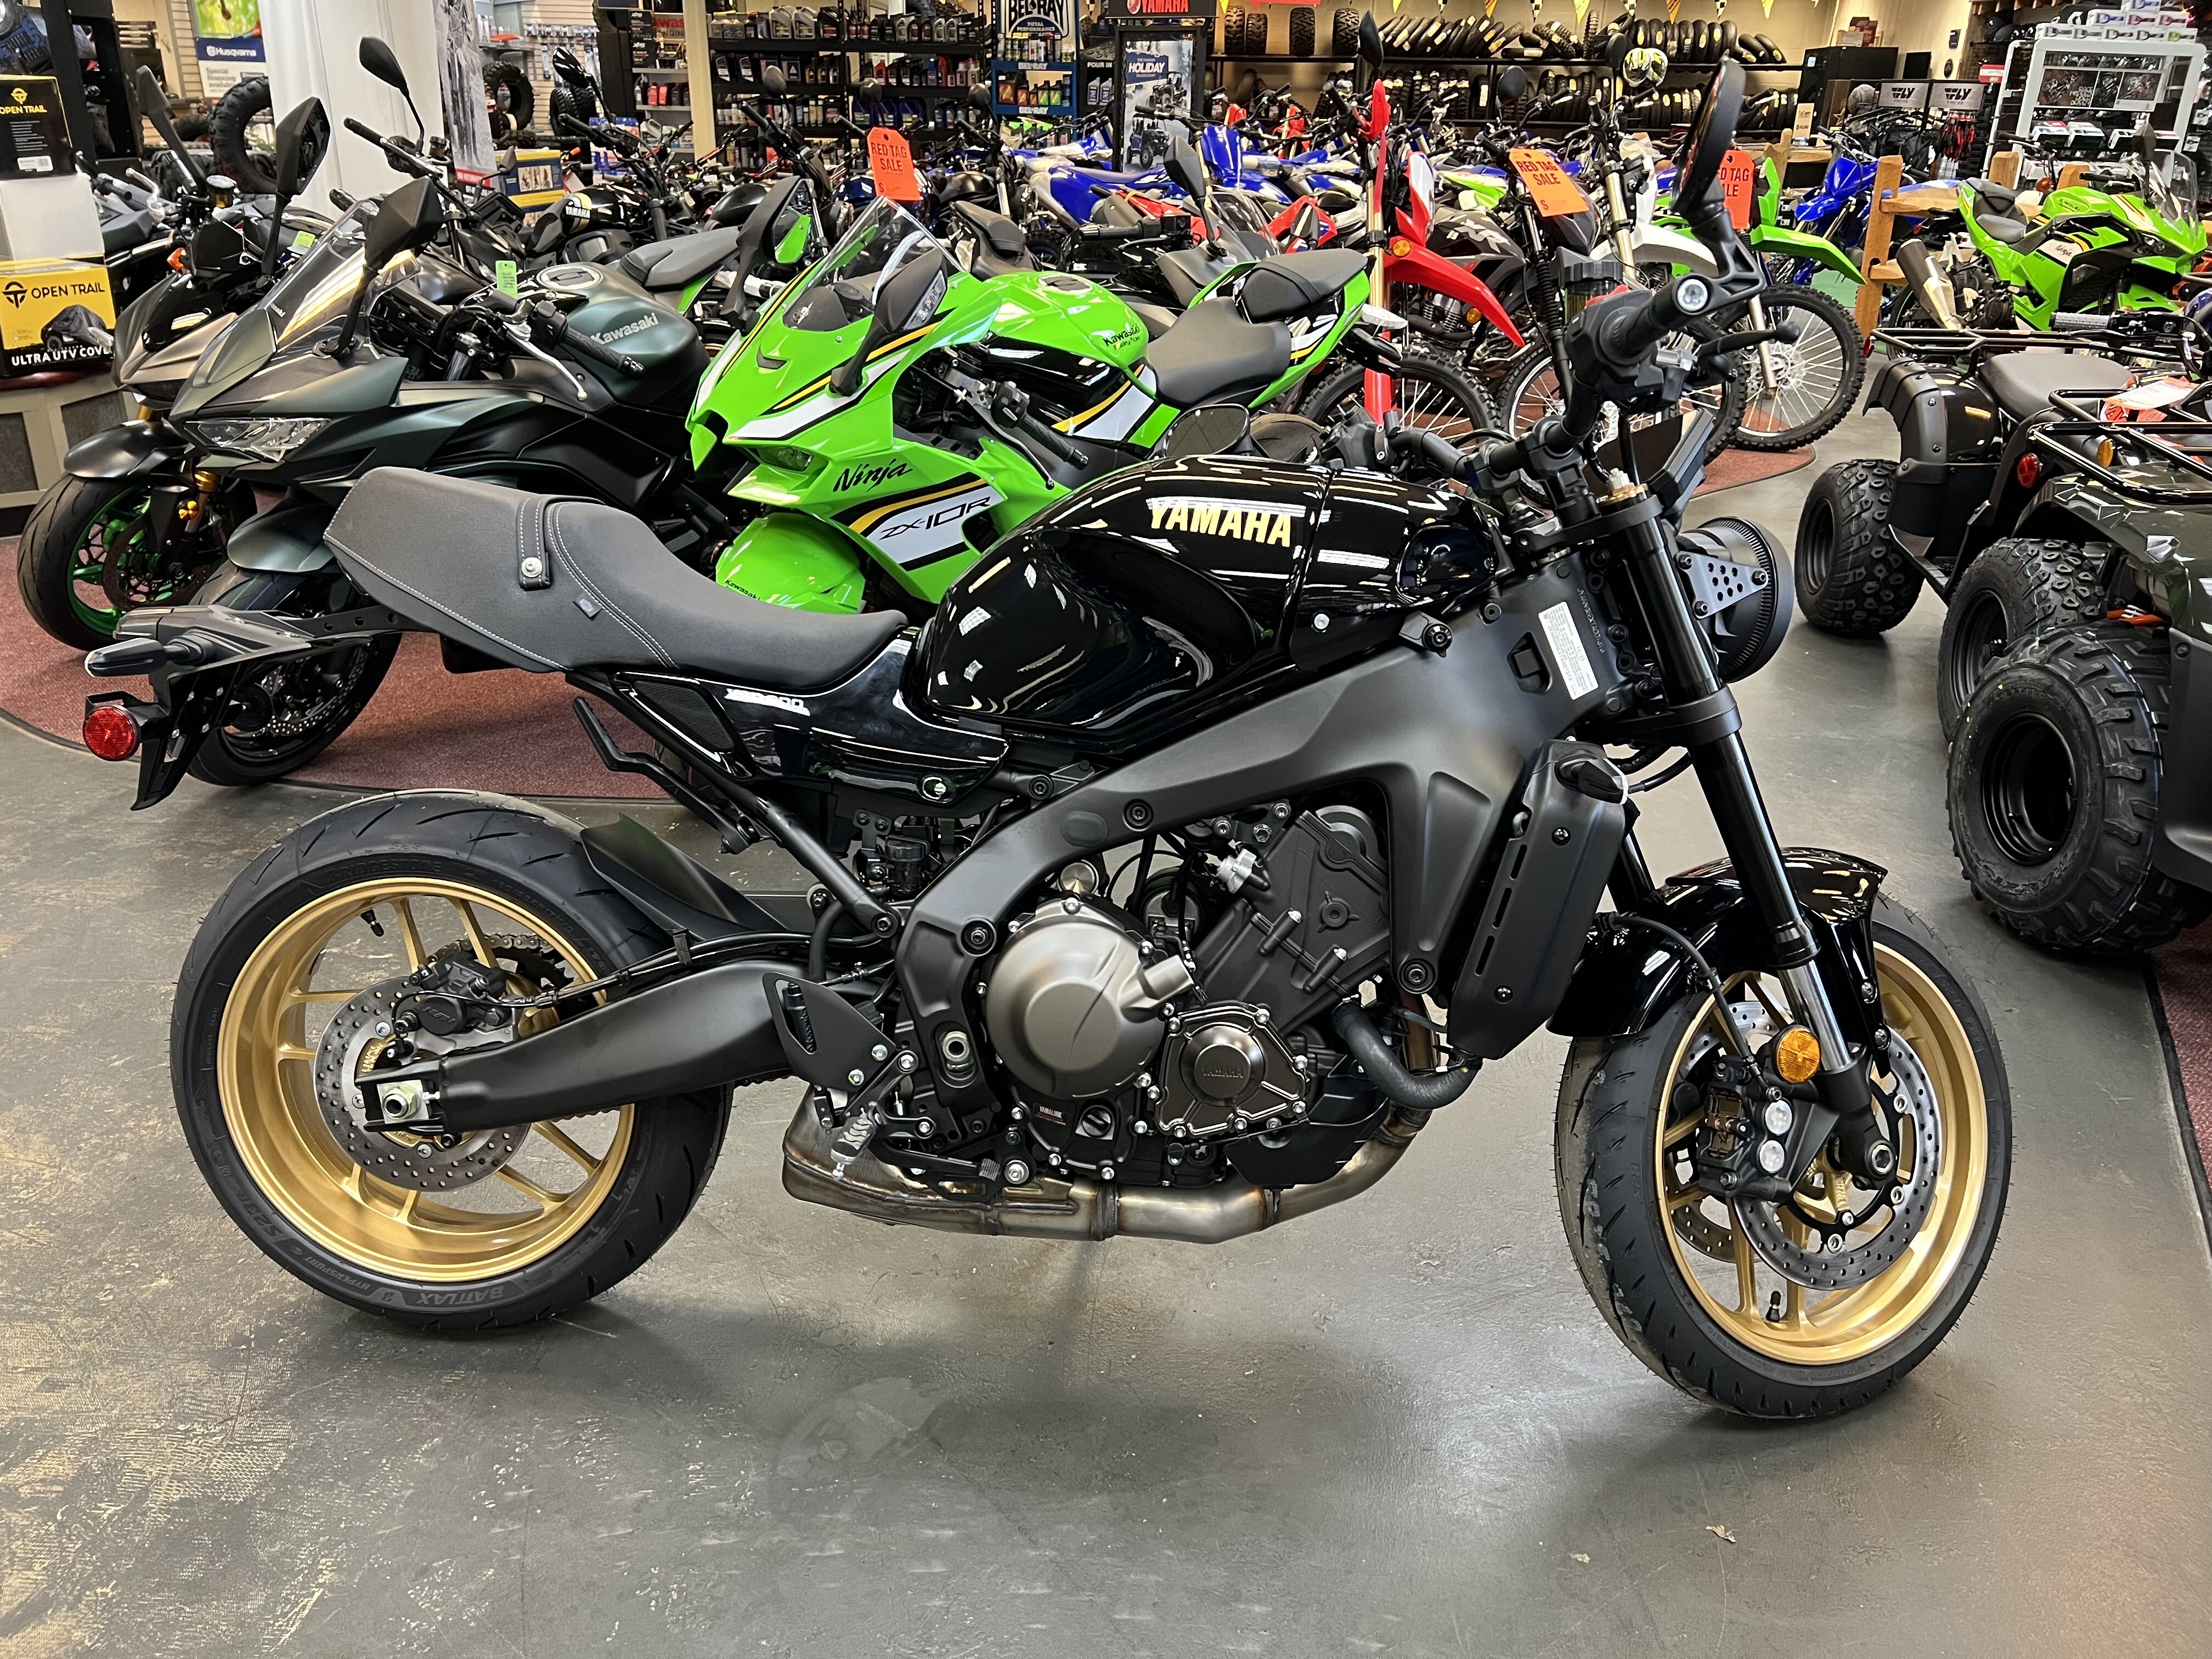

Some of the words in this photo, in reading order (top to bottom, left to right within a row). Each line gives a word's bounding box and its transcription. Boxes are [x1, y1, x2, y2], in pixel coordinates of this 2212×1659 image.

[1142, 0, 1189, 13] YAMAHA
[216, 48, 257, 57] Husqvarna
[1128, 63, 1165, 73] HOLIDAY
[0, 106, 23, 114] OPEN
[871, 142, 888, 156] RED
[889, 145, 907, 158] TAG
[880, 158, 903, 172] SALE
[1515, 161, 1539, 172] RED
[1536, 161, 1559, 171] TAG
[1533, 173, 1561, 185] SALE
[1730, 168, 1750, 182] TAG
[566, 206, 591, 218] YAMAHA
[31, 285, 69, 299] OPEN
[70, 282, 105, 295] TRAIL
[590, 312, 659, 345] Kawasaki
[12, 352, 50, 366] ULTRA
[53, 348, 77, 360] UTV
[833, 458, 913, 493] Ninja
[878, 496, 991, 541] ZX-10R
[1150, 496, 1291, 548] YAMAHA
[1201, 1065, 1244, 1079] YAMAHA
[303, 1255, 371, 1291] HYPERSPORT
[417, 1286, 504, 1306] BATTLAX
